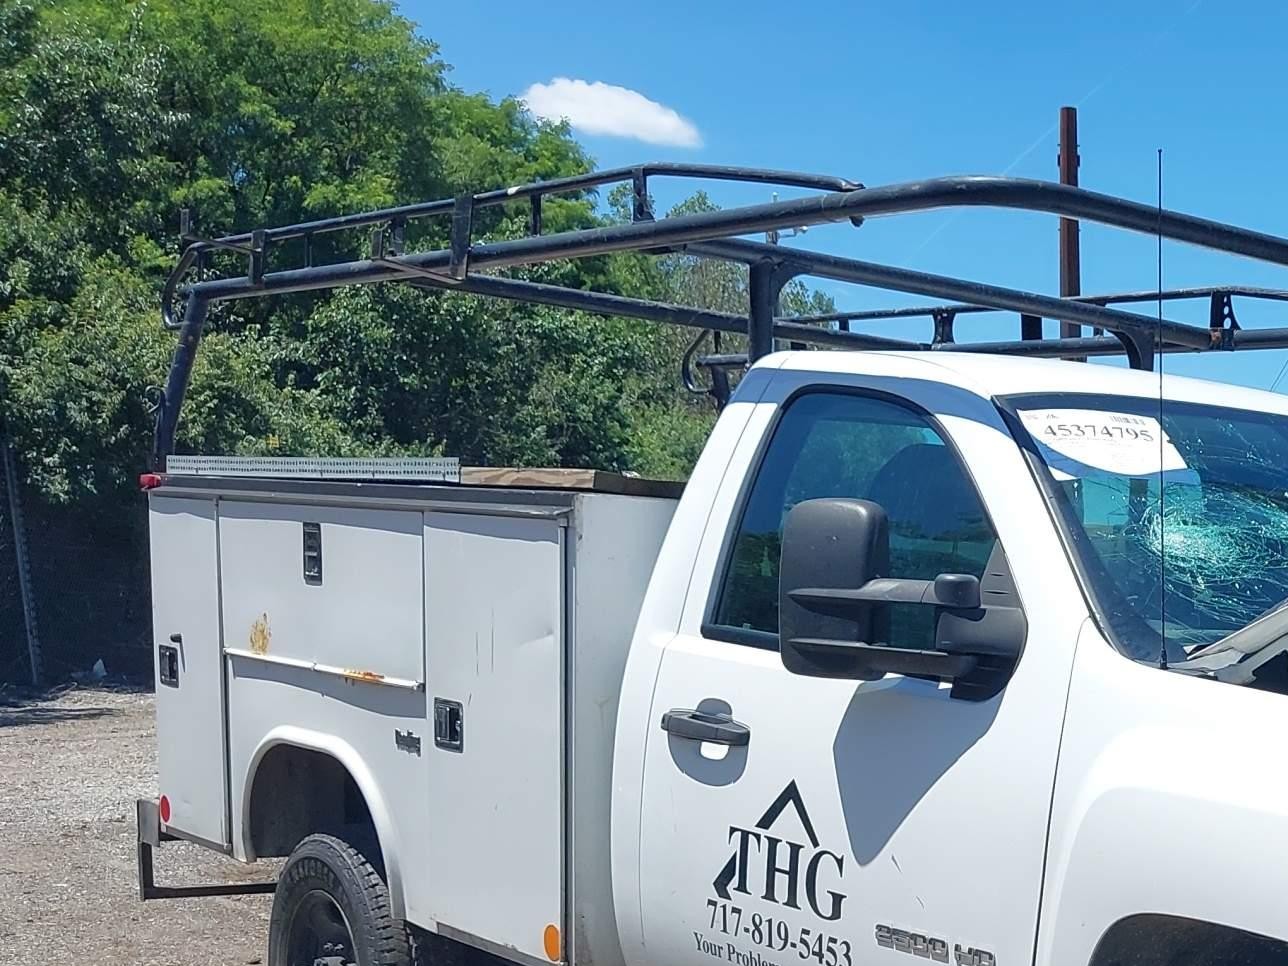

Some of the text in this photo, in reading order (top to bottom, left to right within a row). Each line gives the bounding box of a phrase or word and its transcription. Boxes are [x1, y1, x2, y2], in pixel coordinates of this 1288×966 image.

[1044, 424, 1154, 442] 45374795
[728, 825, 848, 921] THG
[693, 931, 724, 959] Your
[874, 923, 950, 964] 2500
